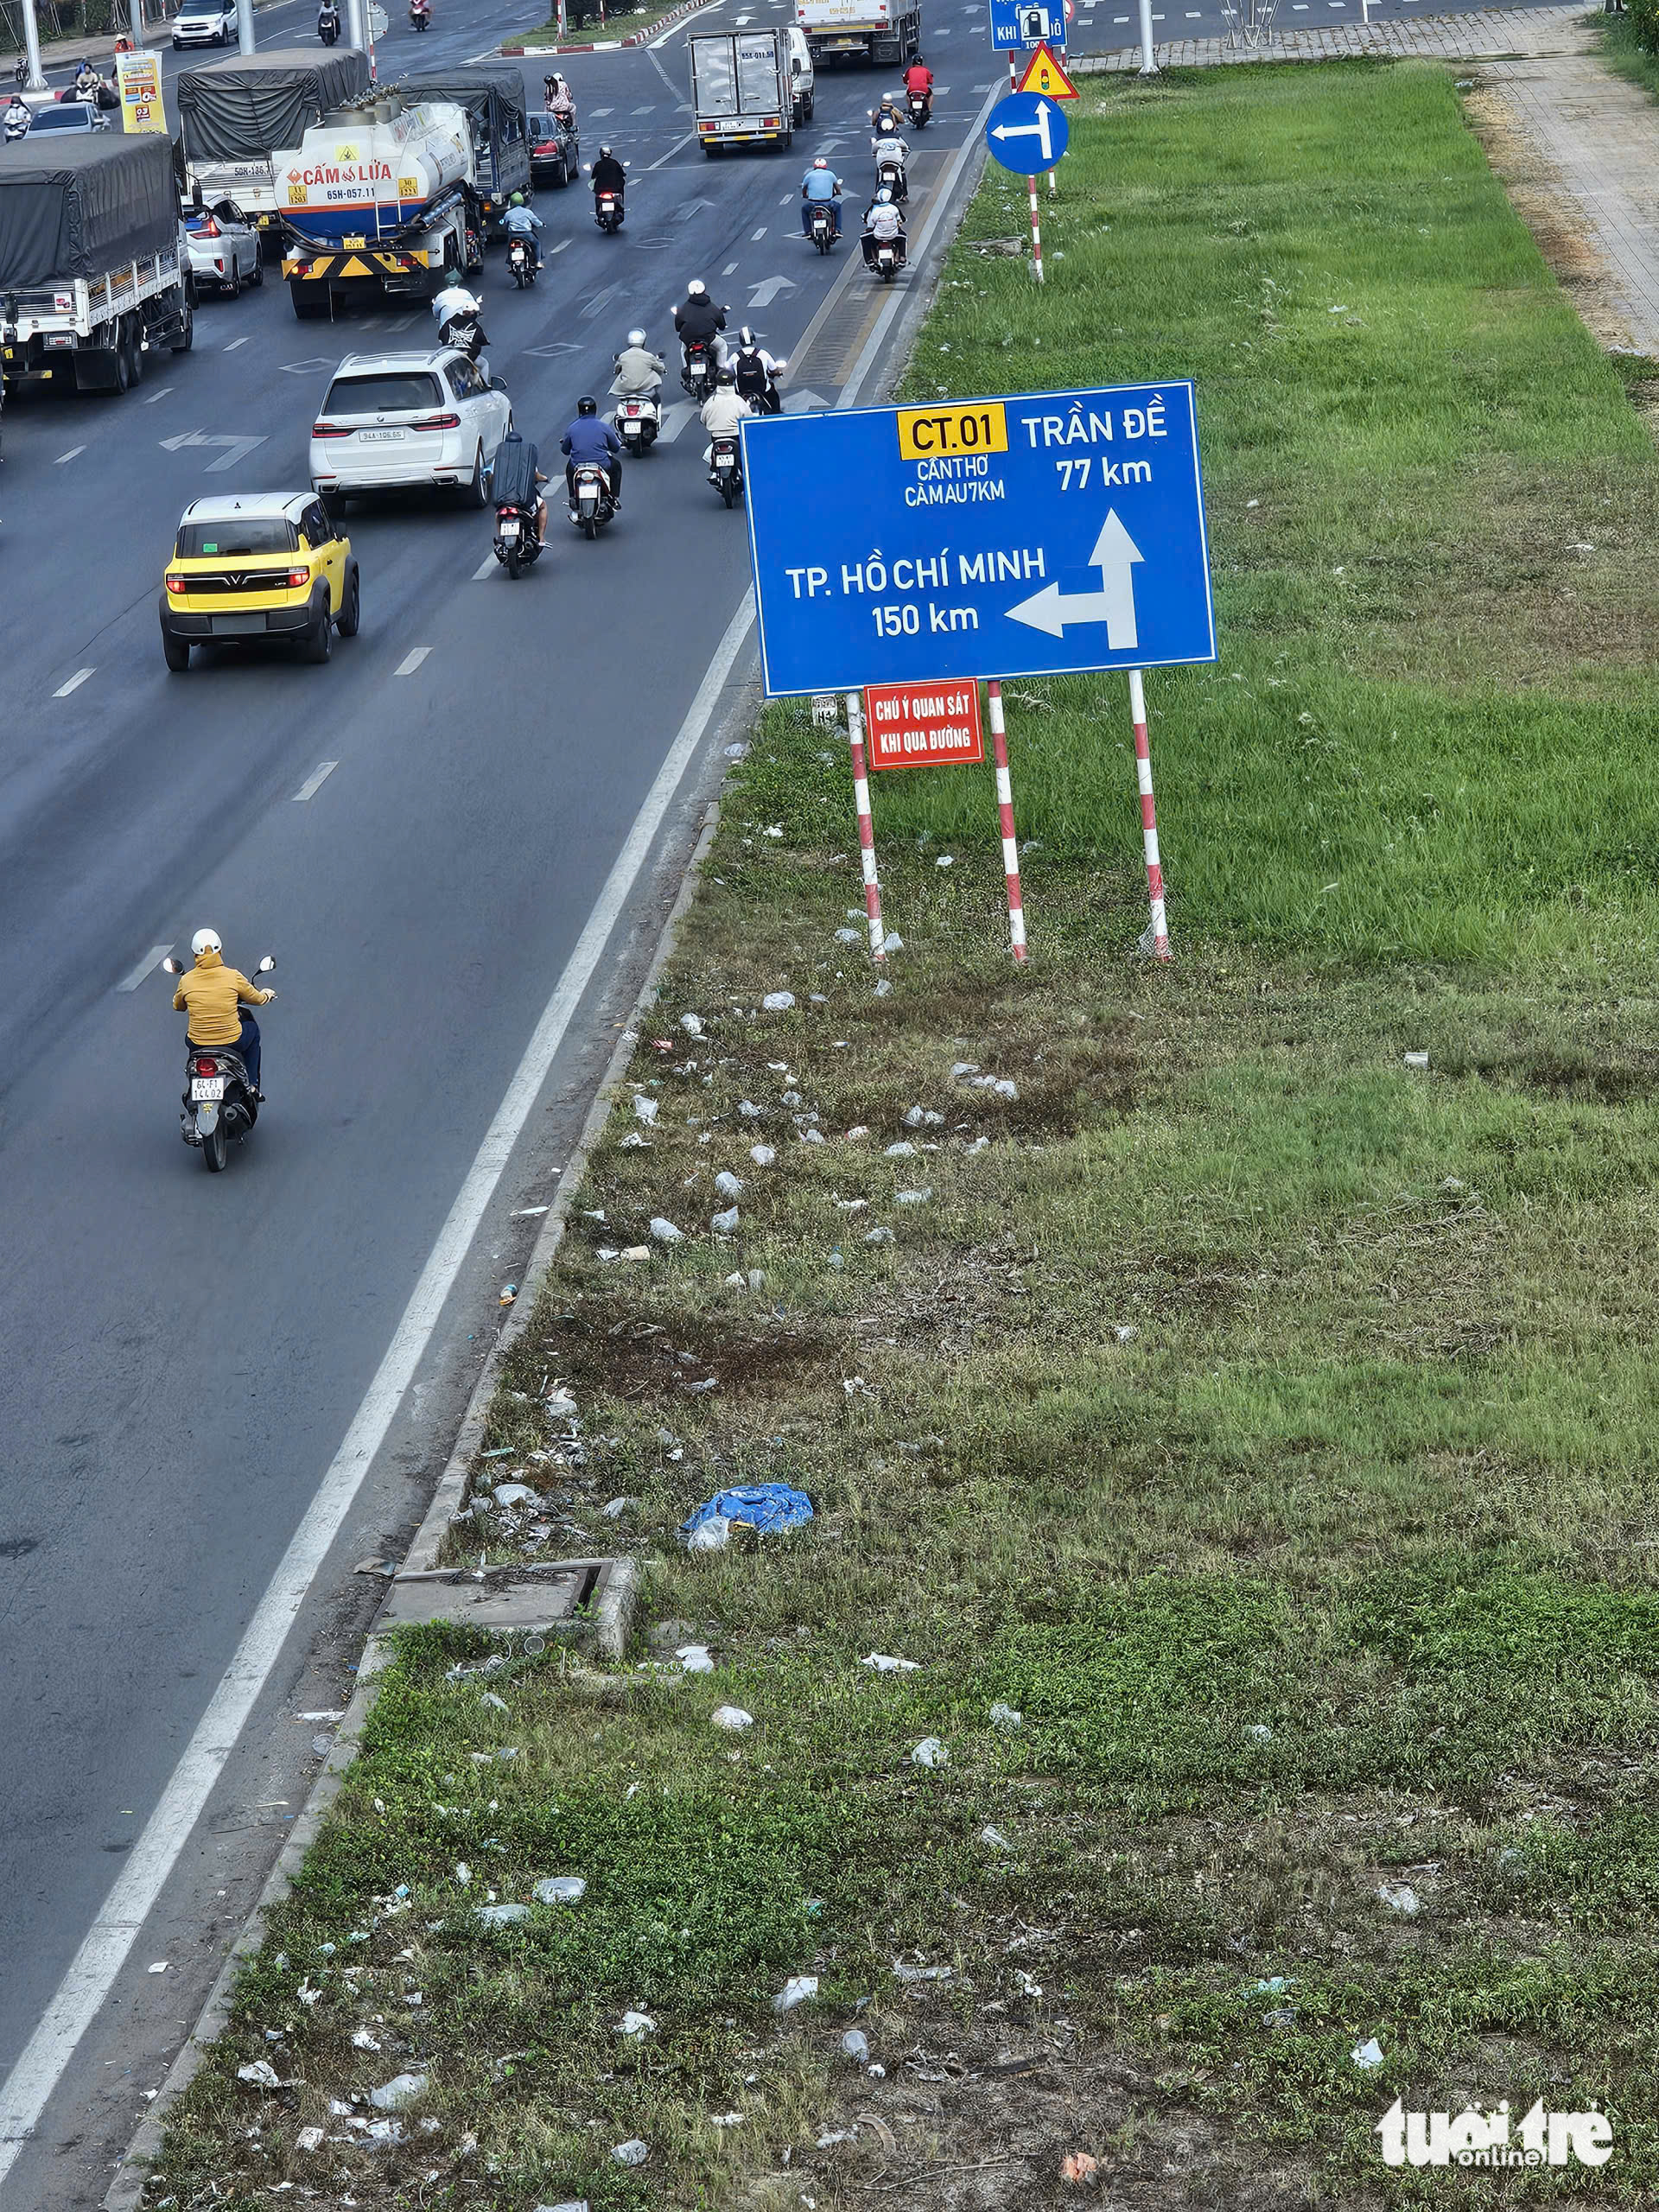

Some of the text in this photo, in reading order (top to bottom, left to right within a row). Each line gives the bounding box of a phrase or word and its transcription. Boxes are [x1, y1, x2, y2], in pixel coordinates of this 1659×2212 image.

[997, 26, 1017, 41] KHI
[303, 159, 391, 185] CẤM LỬA
[327, 188, 375, 200] 65H-057.11
[912, 414, 992, 450] CT.01
[1021, 393, 1167, 448] TRẦN ĐỀ
[1056, 456, 1153, 491] 77 km
[785, 548, 1045, 598] TP. HỒ CHÍ MINH
[872, 603, 979, 637] 150 km
[875, 690, 969, 721] CHÚ Ý QUAN SÁT
[880, 724, 971, 753] KHI QUA ĐƯỜNG
